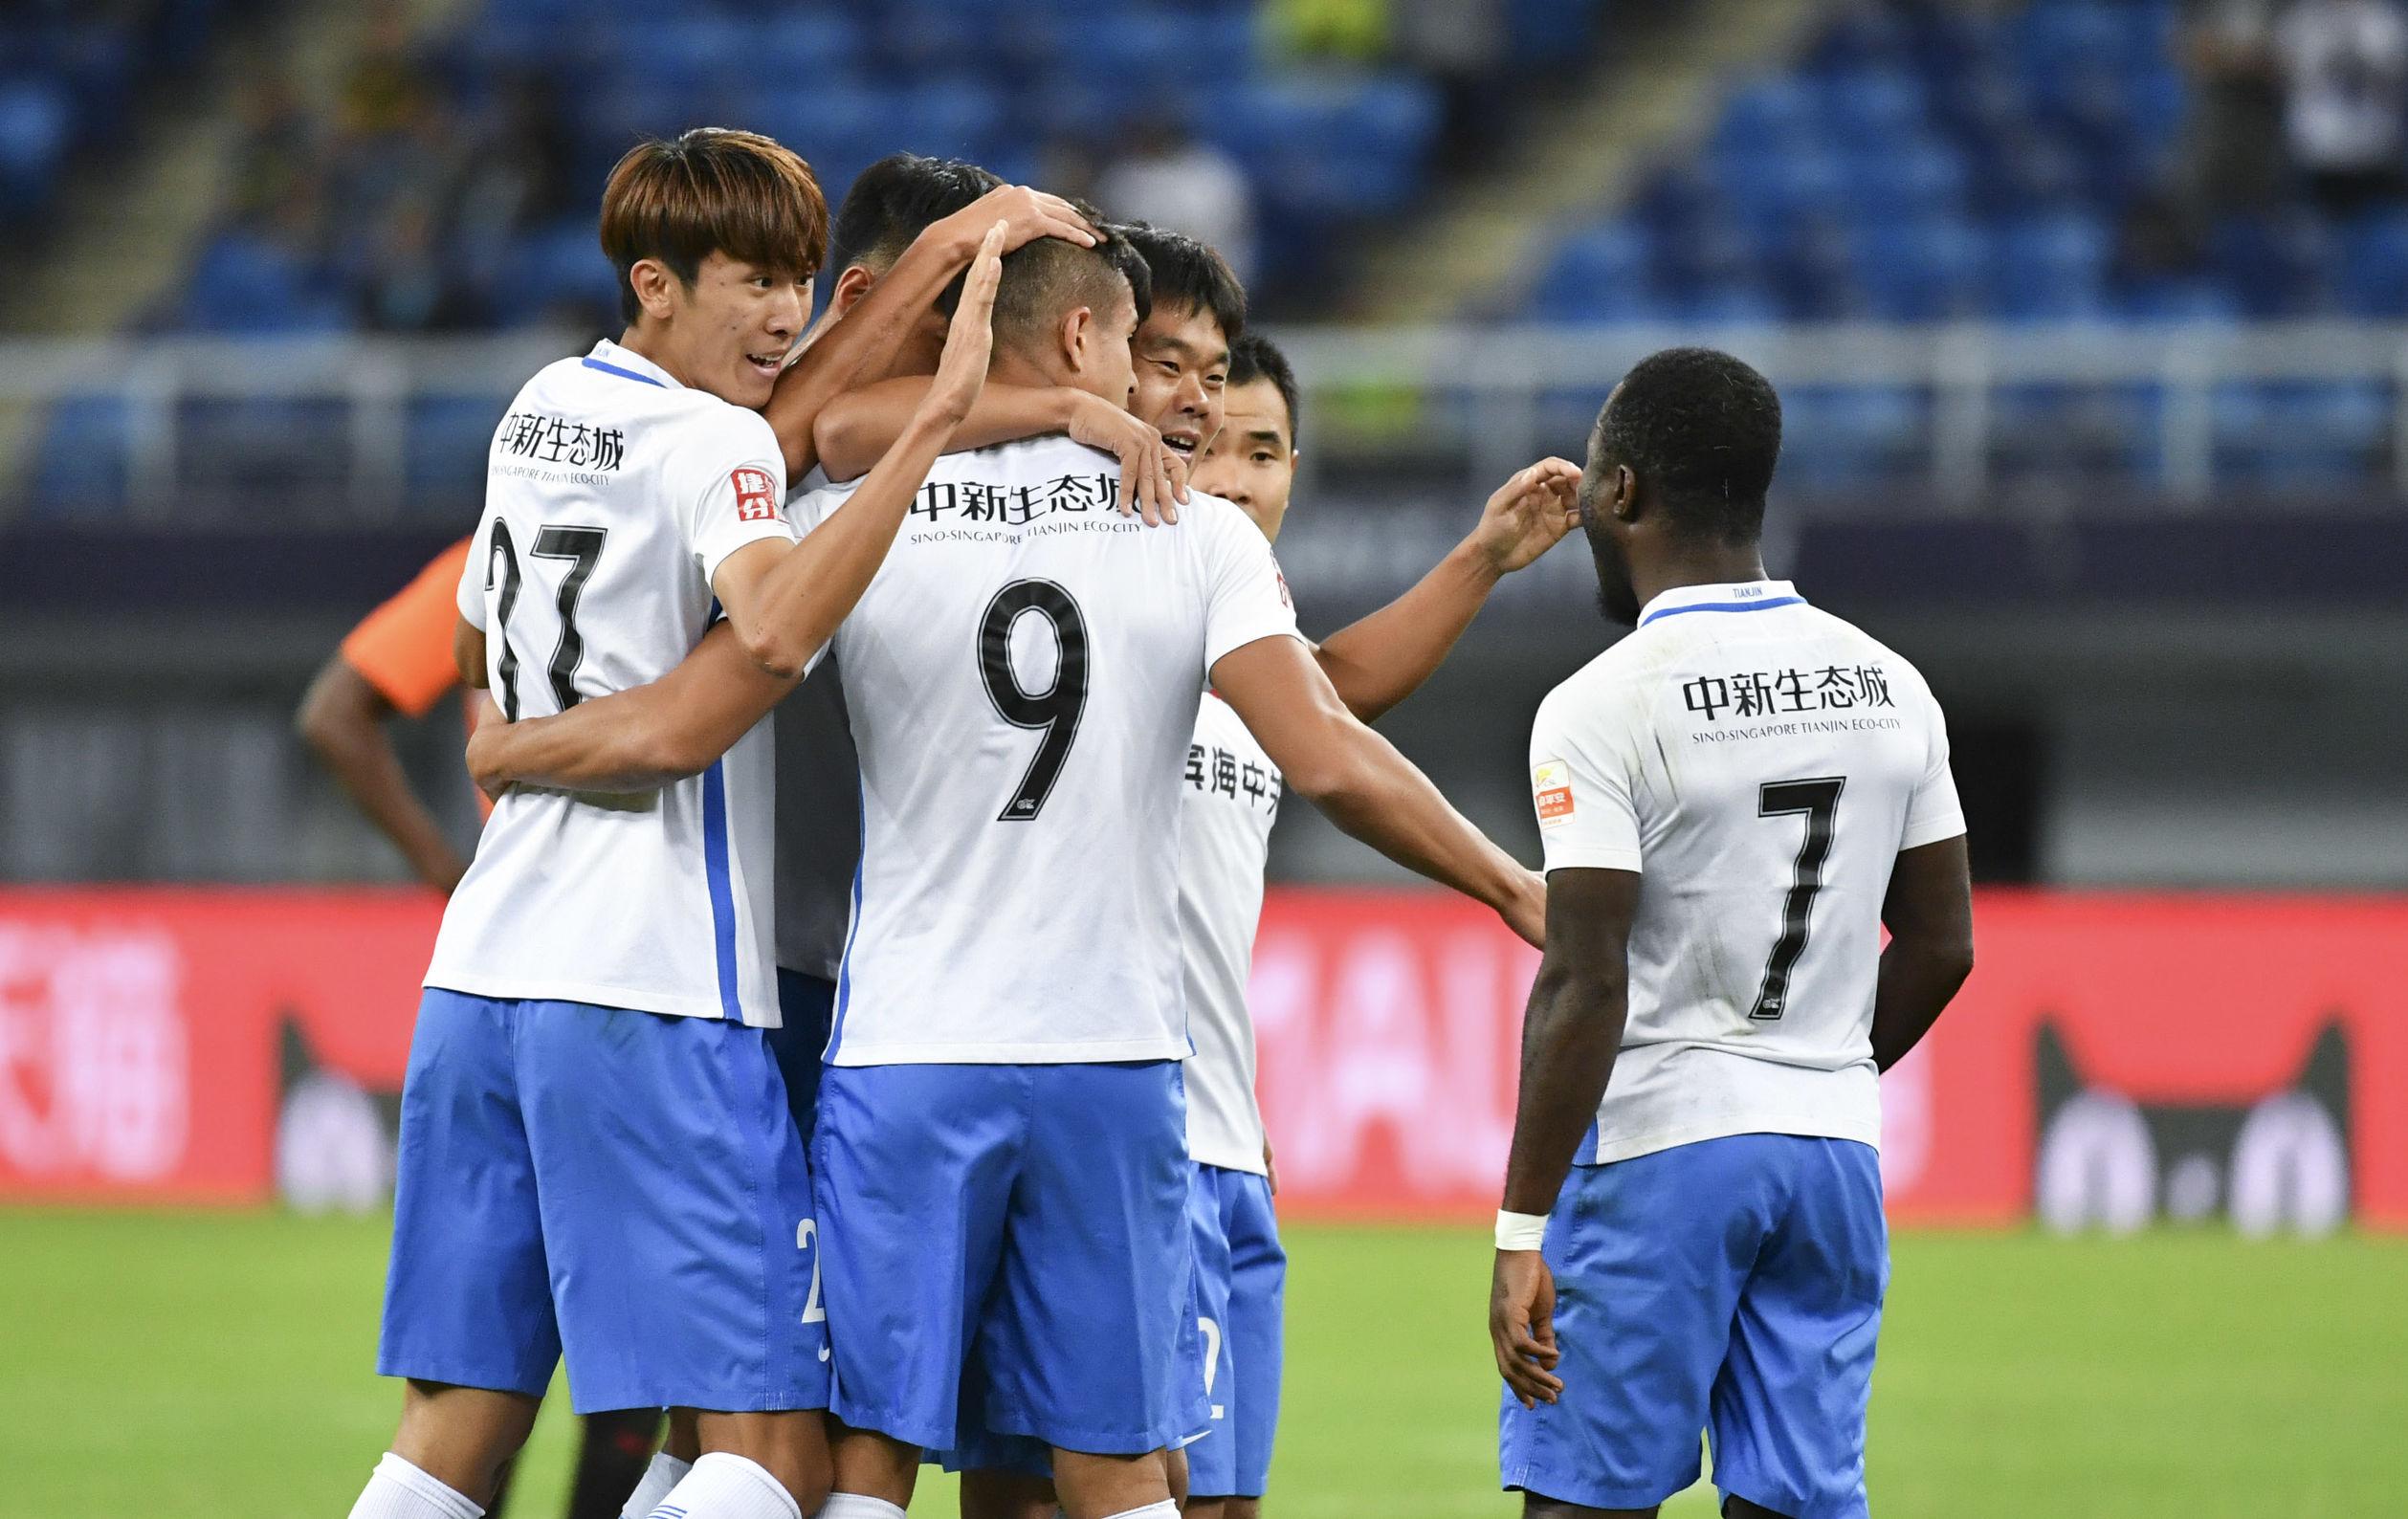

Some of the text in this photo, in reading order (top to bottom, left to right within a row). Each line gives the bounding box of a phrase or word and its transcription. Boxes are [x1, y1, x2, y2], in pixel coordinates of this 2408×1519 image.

[499, 411, 624, 472] 中新生态城
[570, 473, 610, 486] ECO-CITY
[910, 529, 1023, 545] SINO-SINGAPORE
[1027, 521, 1079, 538] TIANJIN
[1732, 585, 1763, 599] TIANJIN
[977, 576, 1090, 822] 9
[1682, 664, 1896, 721] 中新生态城
[1691, 717, 1902, 745] SINO-SINGAPORE TIANJIN ECO-CITY
[1749, 776, 1847, 1021] 7
